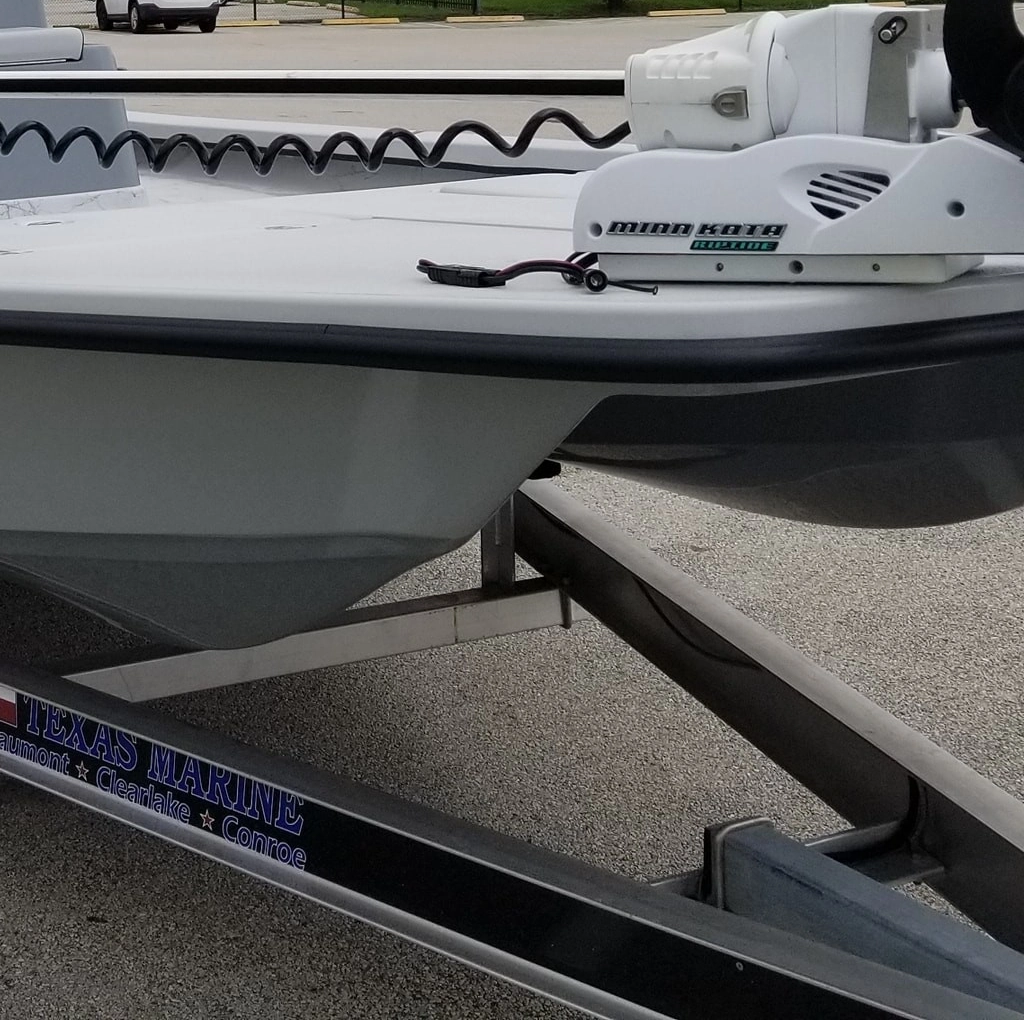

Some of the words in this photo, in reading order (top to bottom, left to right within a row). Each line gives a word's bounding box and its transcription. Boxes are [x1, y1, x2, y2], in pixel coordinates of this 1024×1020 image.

[691, 240, 778, 251] RIPTIDE
[24, 694, 138, 771] TEXAS
[148, 742, 305, 836] MARINE
[95, 765, 191, 823] Clearlake
[221, 815, 307, 871] Conroe
